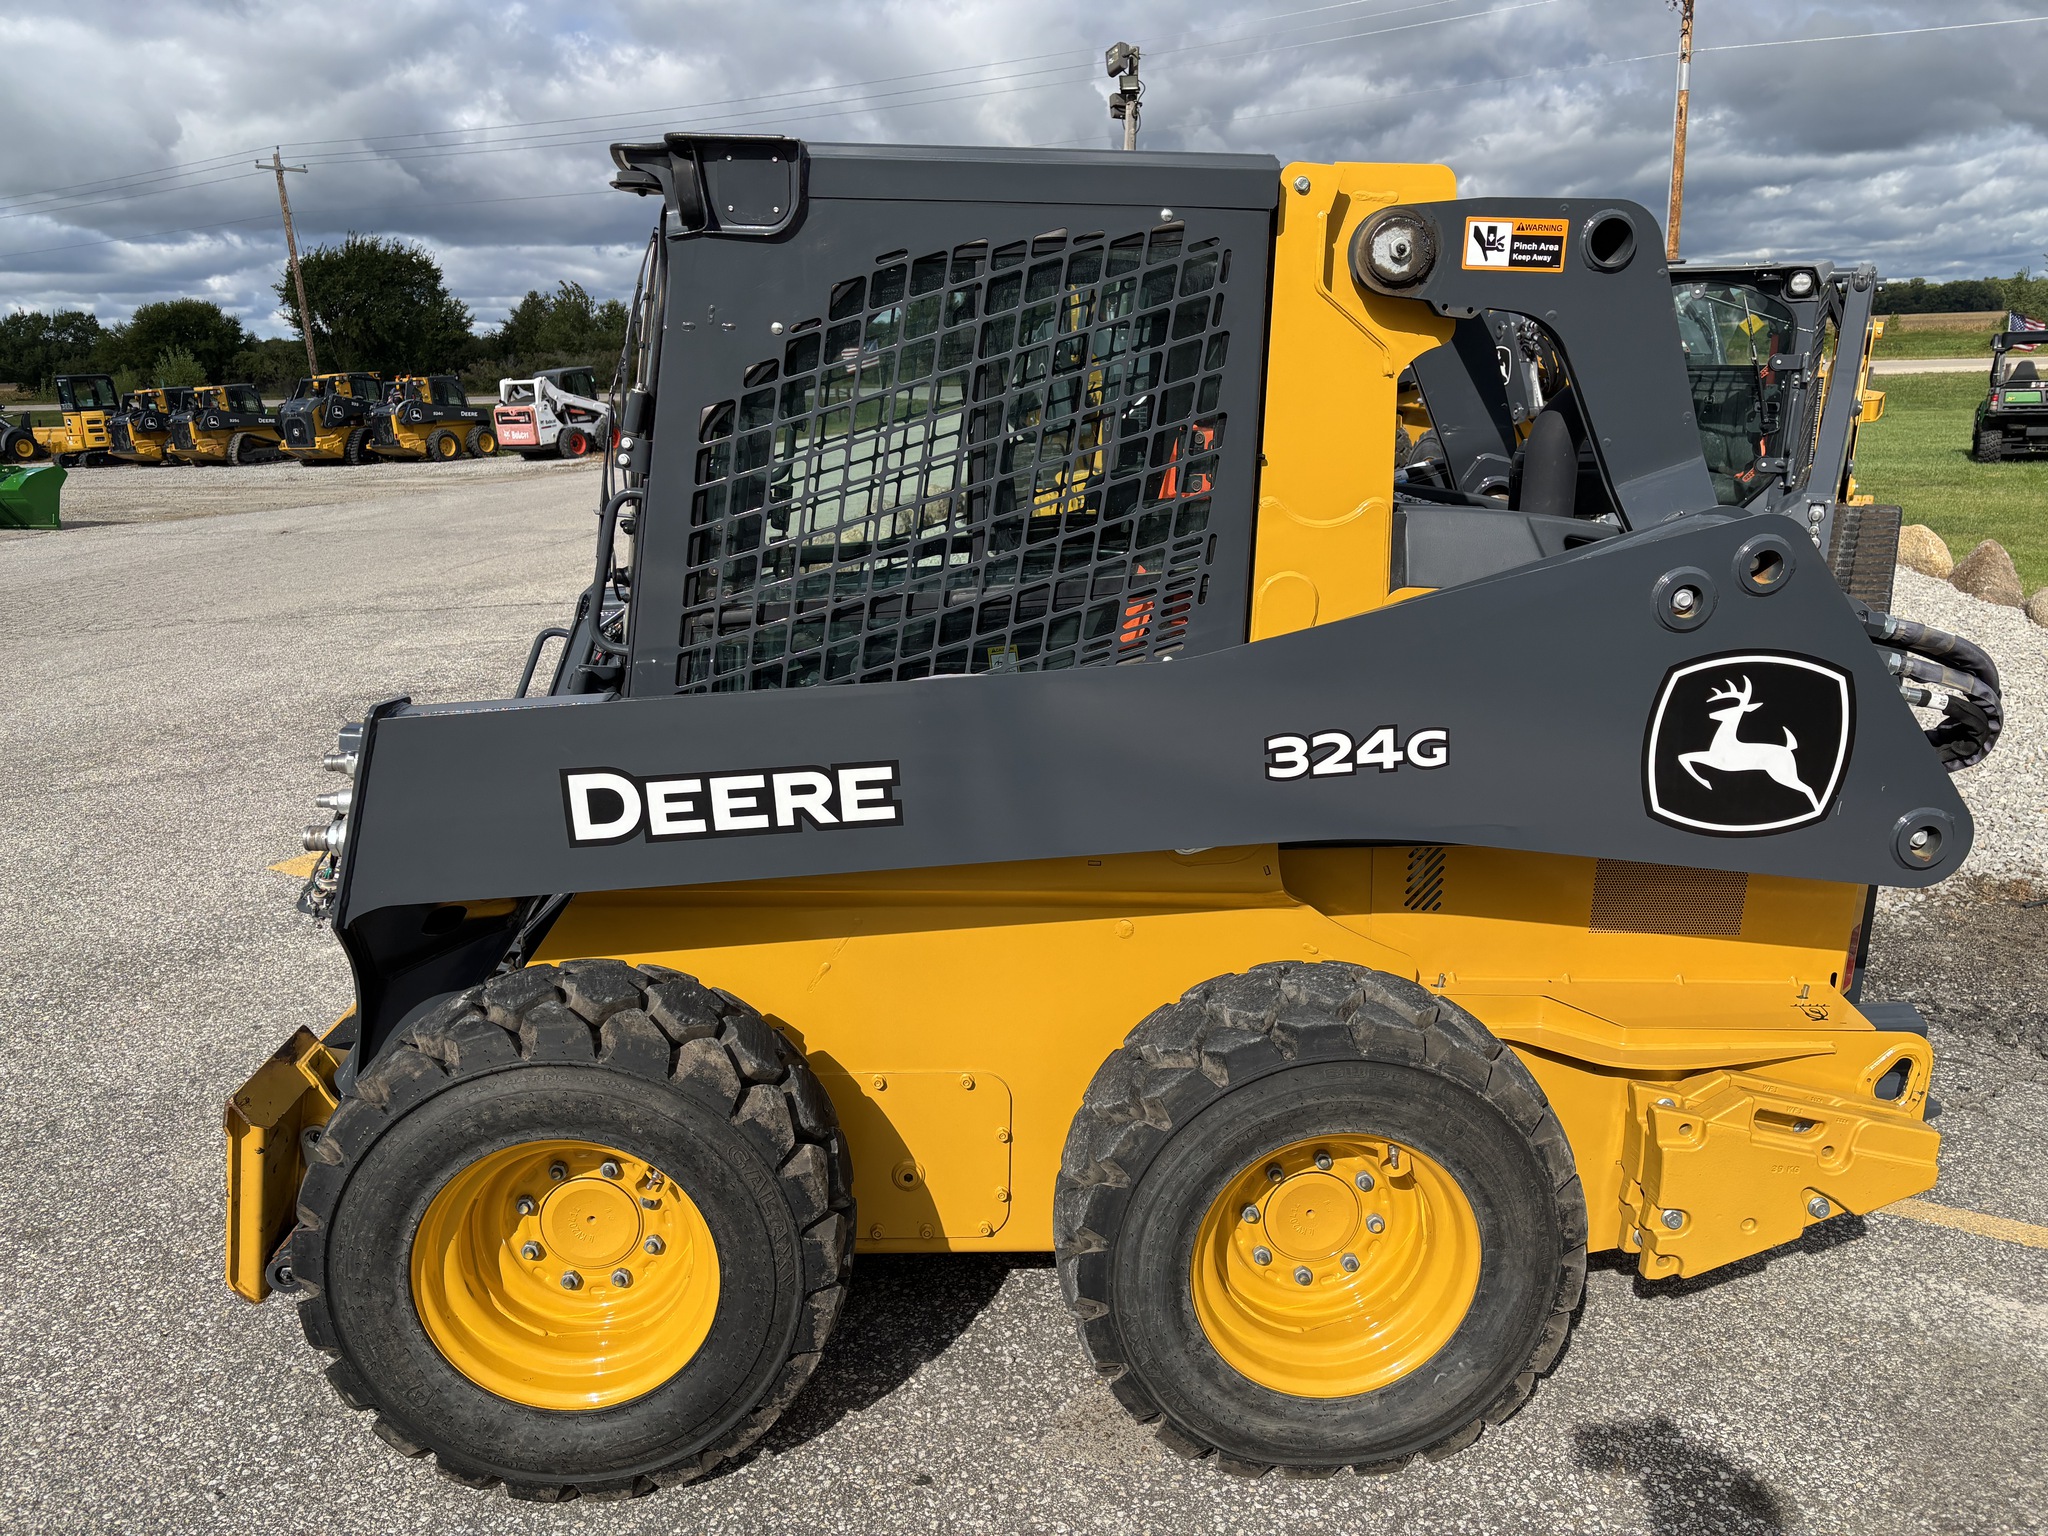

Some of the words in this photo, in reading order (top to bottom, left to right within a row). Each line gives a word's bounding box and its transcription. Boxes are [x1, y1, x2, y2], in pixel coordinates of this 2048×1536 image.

[1525, 224, 1563, 232] WARNING
[1514, 242, 1538, 251] Pinch
[1539, 242, 1559, 251] Area
[1513, 253, 1531, 262] Keep
[1532, 254, 1551, 262] Away
[511, 431, 529, 440] Bobcat
[1267, 727, 1448, 780] 324G
[565, 764, 898, 843] DEERE
[727, 1144, 798, 1297] GALAXY
